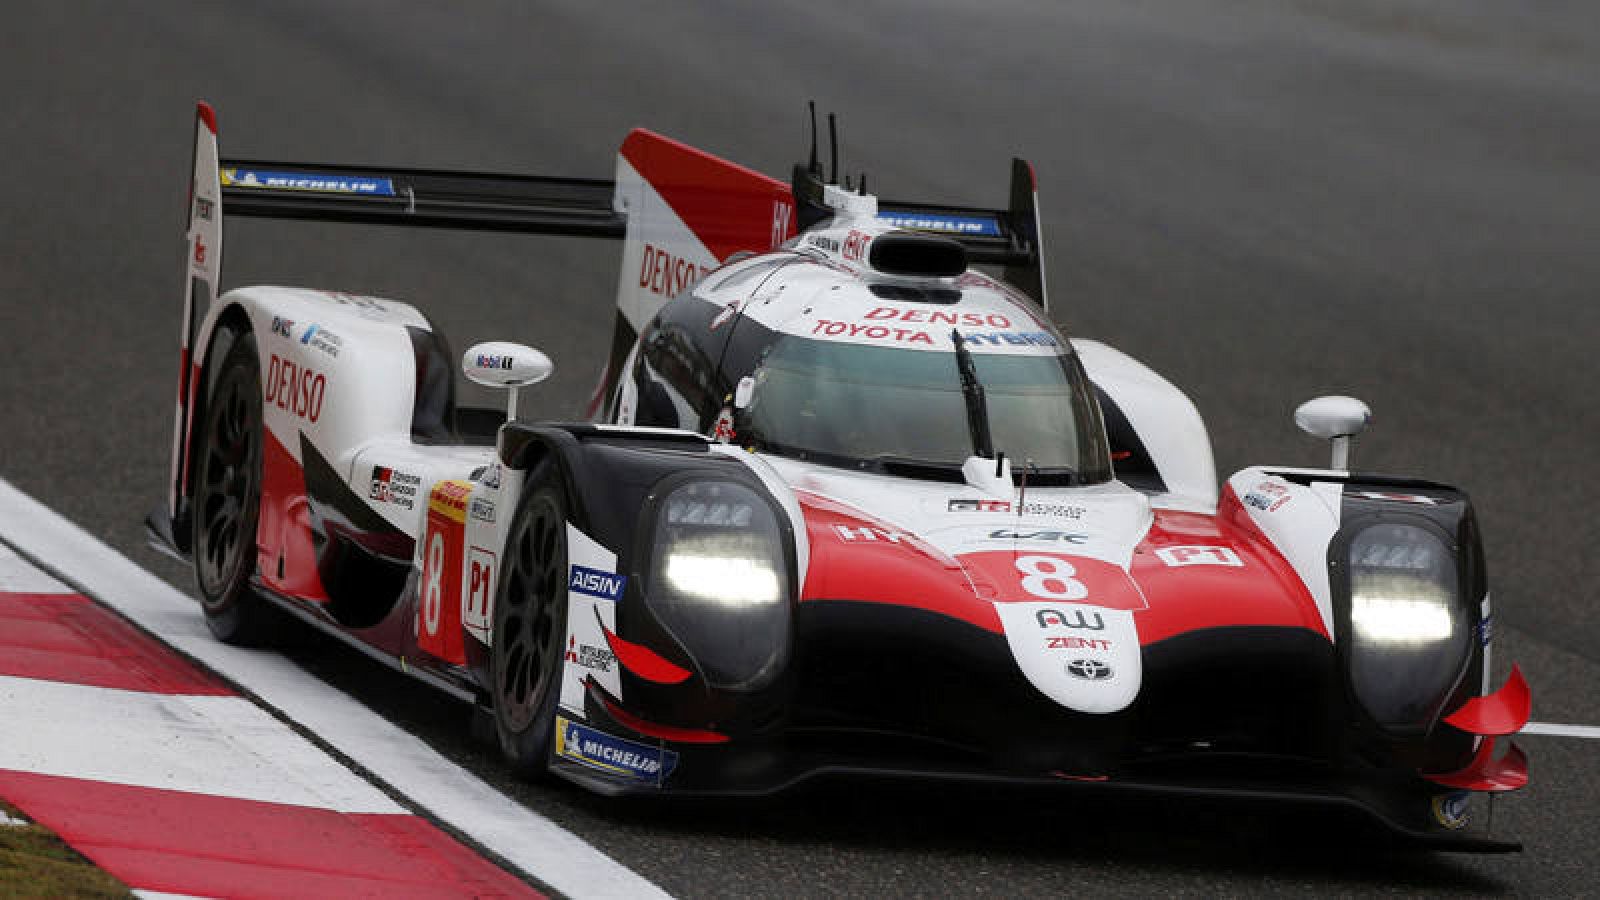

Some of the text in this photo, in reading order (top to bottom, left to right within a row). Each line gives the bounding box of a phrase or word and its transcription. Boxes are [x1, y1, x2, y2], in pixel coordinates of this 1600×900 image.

[267, 177, 377, 191] MICHELIN
[639, 243, 697, 300] DENSO
[812, 319, 934, 344] TOYOTA
[863, 307, 1012, 328] DENSO
[265, 353, 326, 423] DENSO
[1167, 548, 1230, 562] P1
[425, 531, 444, 636] 8
[468, 560, 491, 617] P1
[571, 571, 622, 595] AISIN
[1015, 555, 1089, 600] 8
[1045, 637, 1112, 651] ZENT
[583, 740, 661, 774] MICHELIN
